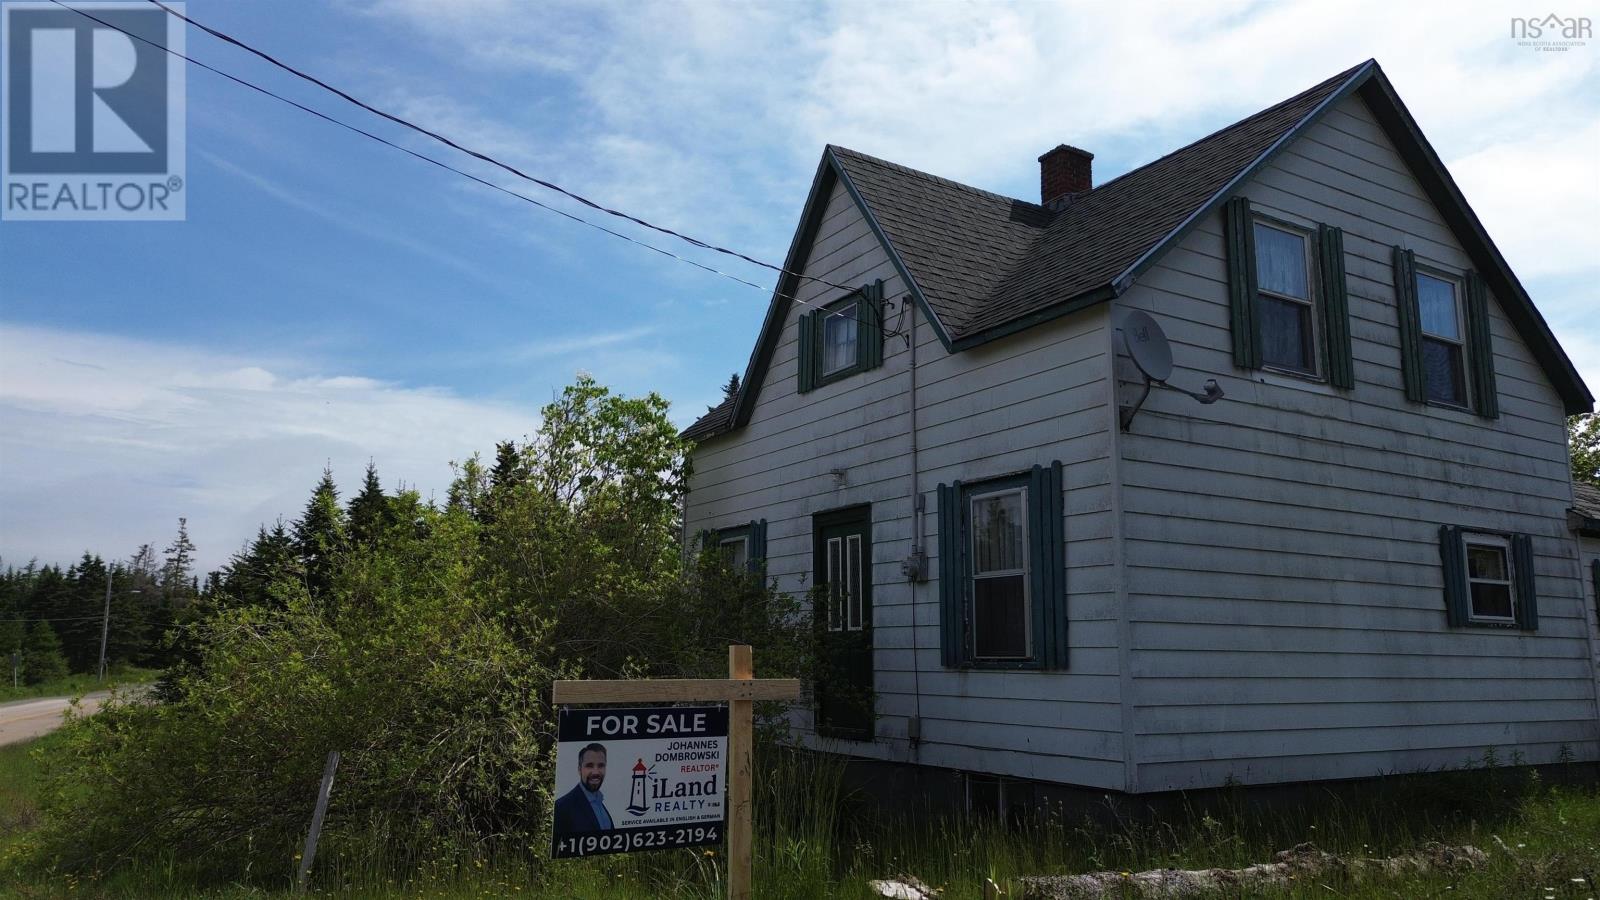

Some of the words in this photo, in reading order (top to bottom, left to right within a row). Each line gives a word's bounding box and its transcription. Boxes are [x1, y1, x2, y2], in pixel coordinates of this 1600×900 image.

[586, 715, 639, 736] FOR
[646, 713, 707, 734] SALE
[667, 740, 718, 751] JOHANNES
[655, 751, 720, 762] DOMBROWSKI
[652, 775, 718, 799] iLand
[654, 799, 706, 812] REALTY
[558, 827, 718, 855] +1(902)623-2194
